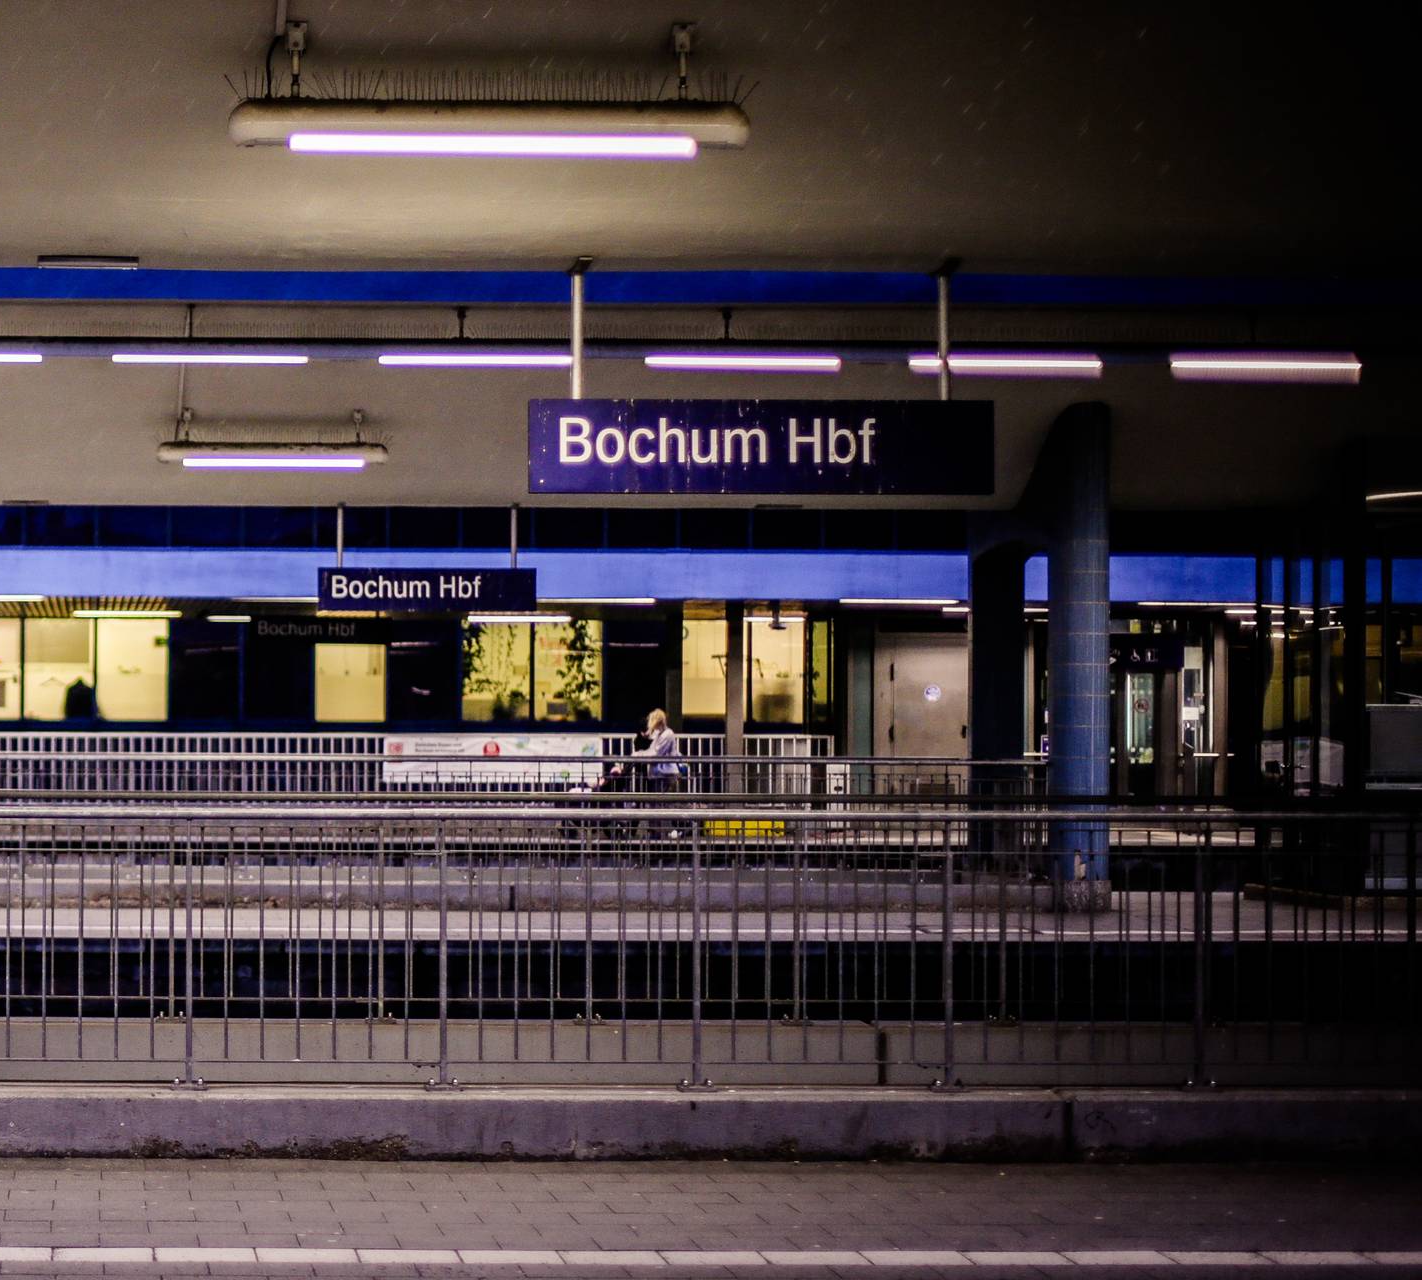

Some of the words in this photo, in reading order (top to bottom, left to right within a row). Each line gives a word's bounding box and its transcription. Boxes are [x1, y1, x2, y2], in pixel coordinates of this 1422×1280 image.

[558, 416, 768, 466] Bochum
[788, 417, 877, 465] Hbf
[330, 574, 431, 600] Bochum
[438, 574, 483, 600] Hbf
[257, 619, 323, 637] Bochum
[327, 621, 356, 638] Hbf
